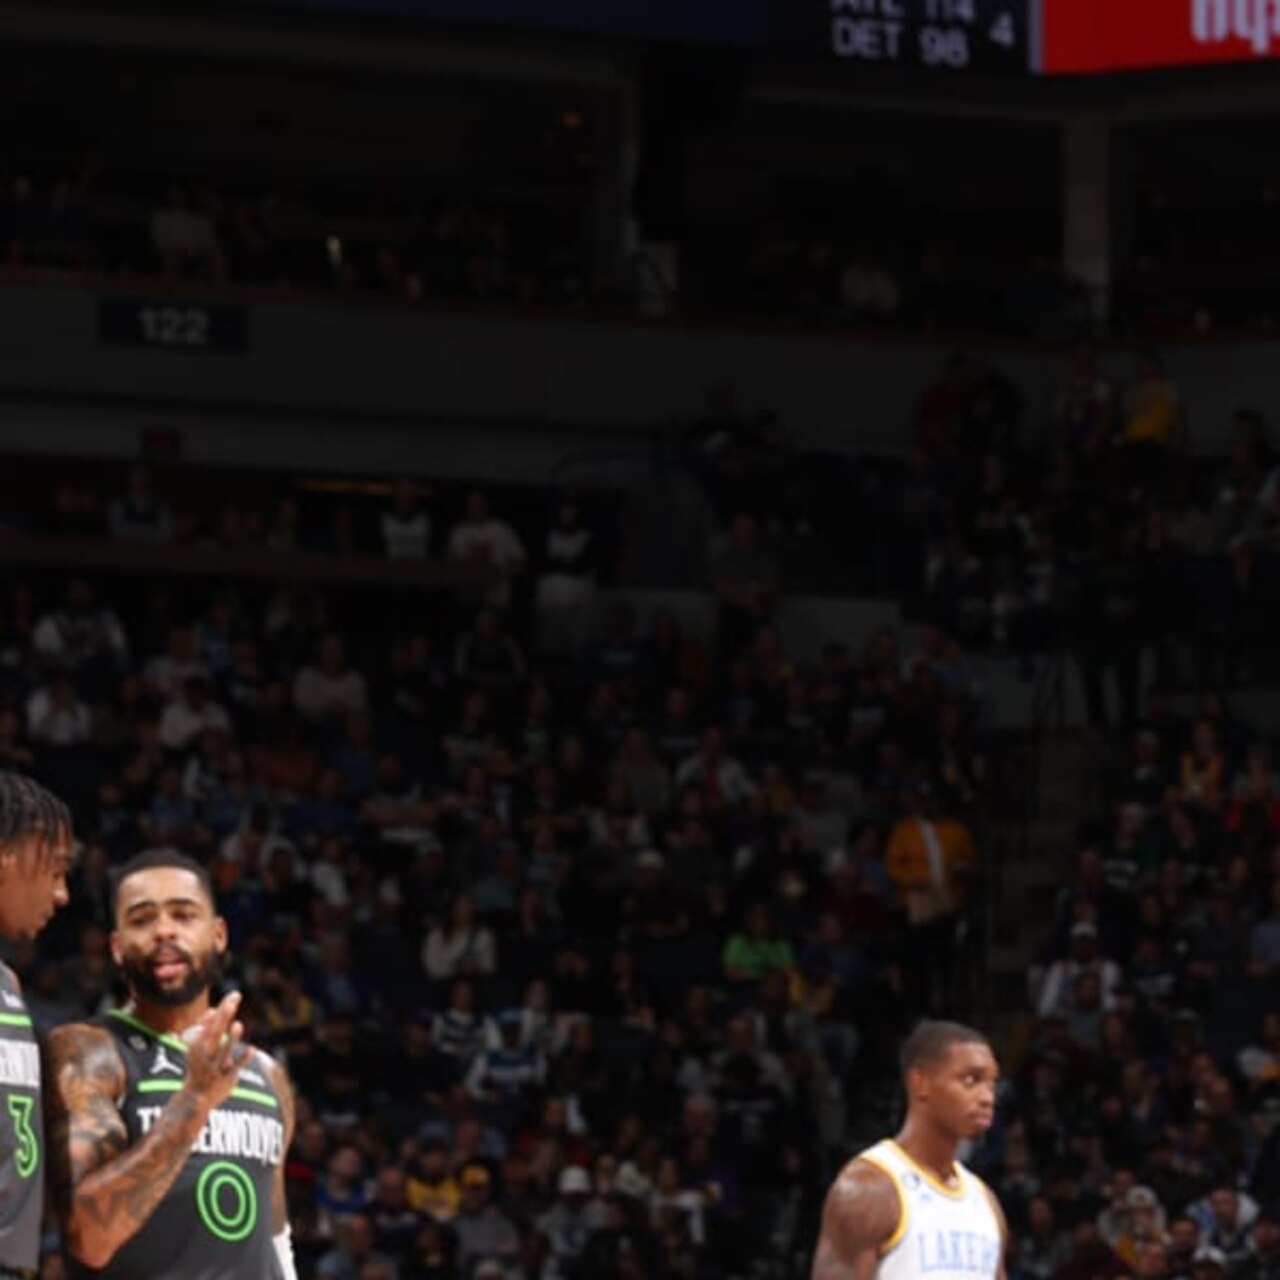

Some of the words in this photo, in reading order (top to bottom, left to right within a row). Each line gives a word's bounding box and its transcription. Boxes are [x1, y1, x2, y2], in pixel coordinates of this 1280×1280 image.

[832, 16, 903, 60] DET
[137, 305, 211, 346] 122
[8, 1094, 39, 1178] 3
[197, 1160, 258, 1242] 0
[917, 1230, 998, 1276] LAKER
